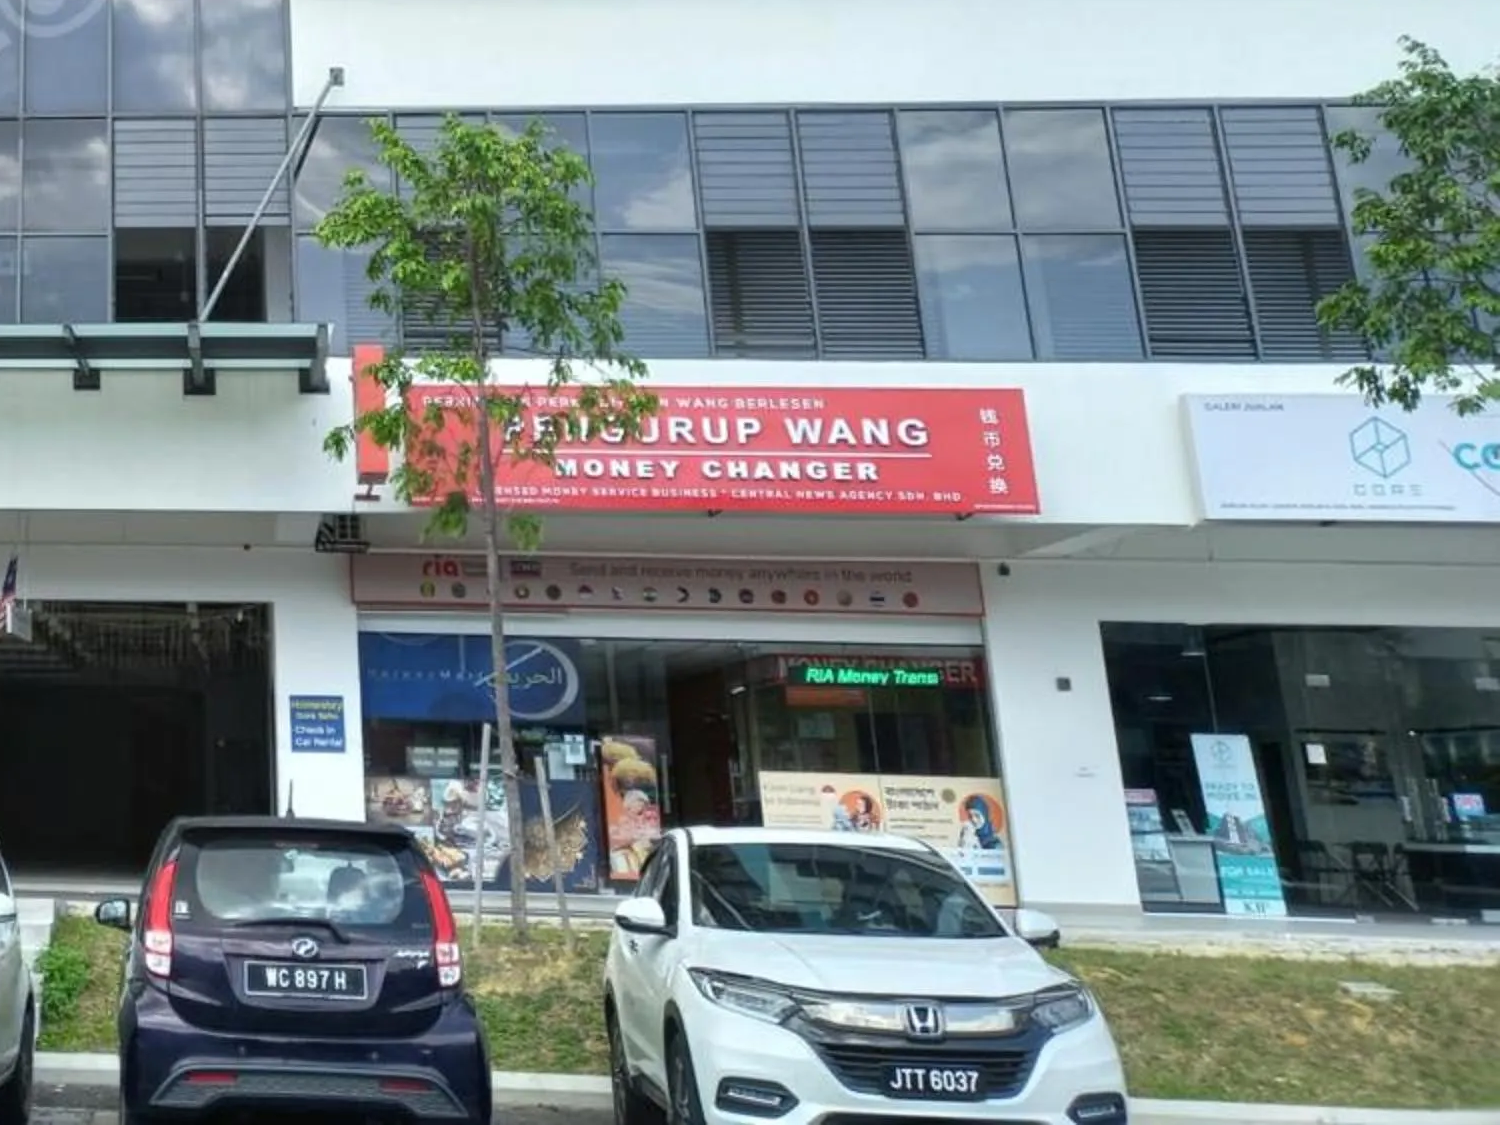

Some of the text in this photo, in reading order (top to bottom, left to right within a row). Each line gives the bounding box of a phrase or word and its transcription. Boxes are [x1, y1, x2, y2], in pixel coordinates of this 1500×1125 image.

[676, 398, 730, 409] WANG
[735, 398, 825, 410] BERLESEN
[784, 416, 928, 446] WANG
[556, 458, 879, 481] MONEY CHANGER
[542, 486, 588, 497] MONEY
[592, 487, 647, 498] SERVICE
[651, 487, 718, 499] BUSINESS
[731, 489, 791, 500] CENTRAL
[796, 490, 834, 500] NEWS
[840, 490, 893, 501] AGENCY
[806, 666, 834, 684] RIA
[838, 668, 889, 686] Money
[265, 967, 348, 991] WC 897 H
[889, 1066, 980, 1094] JTT 6037
